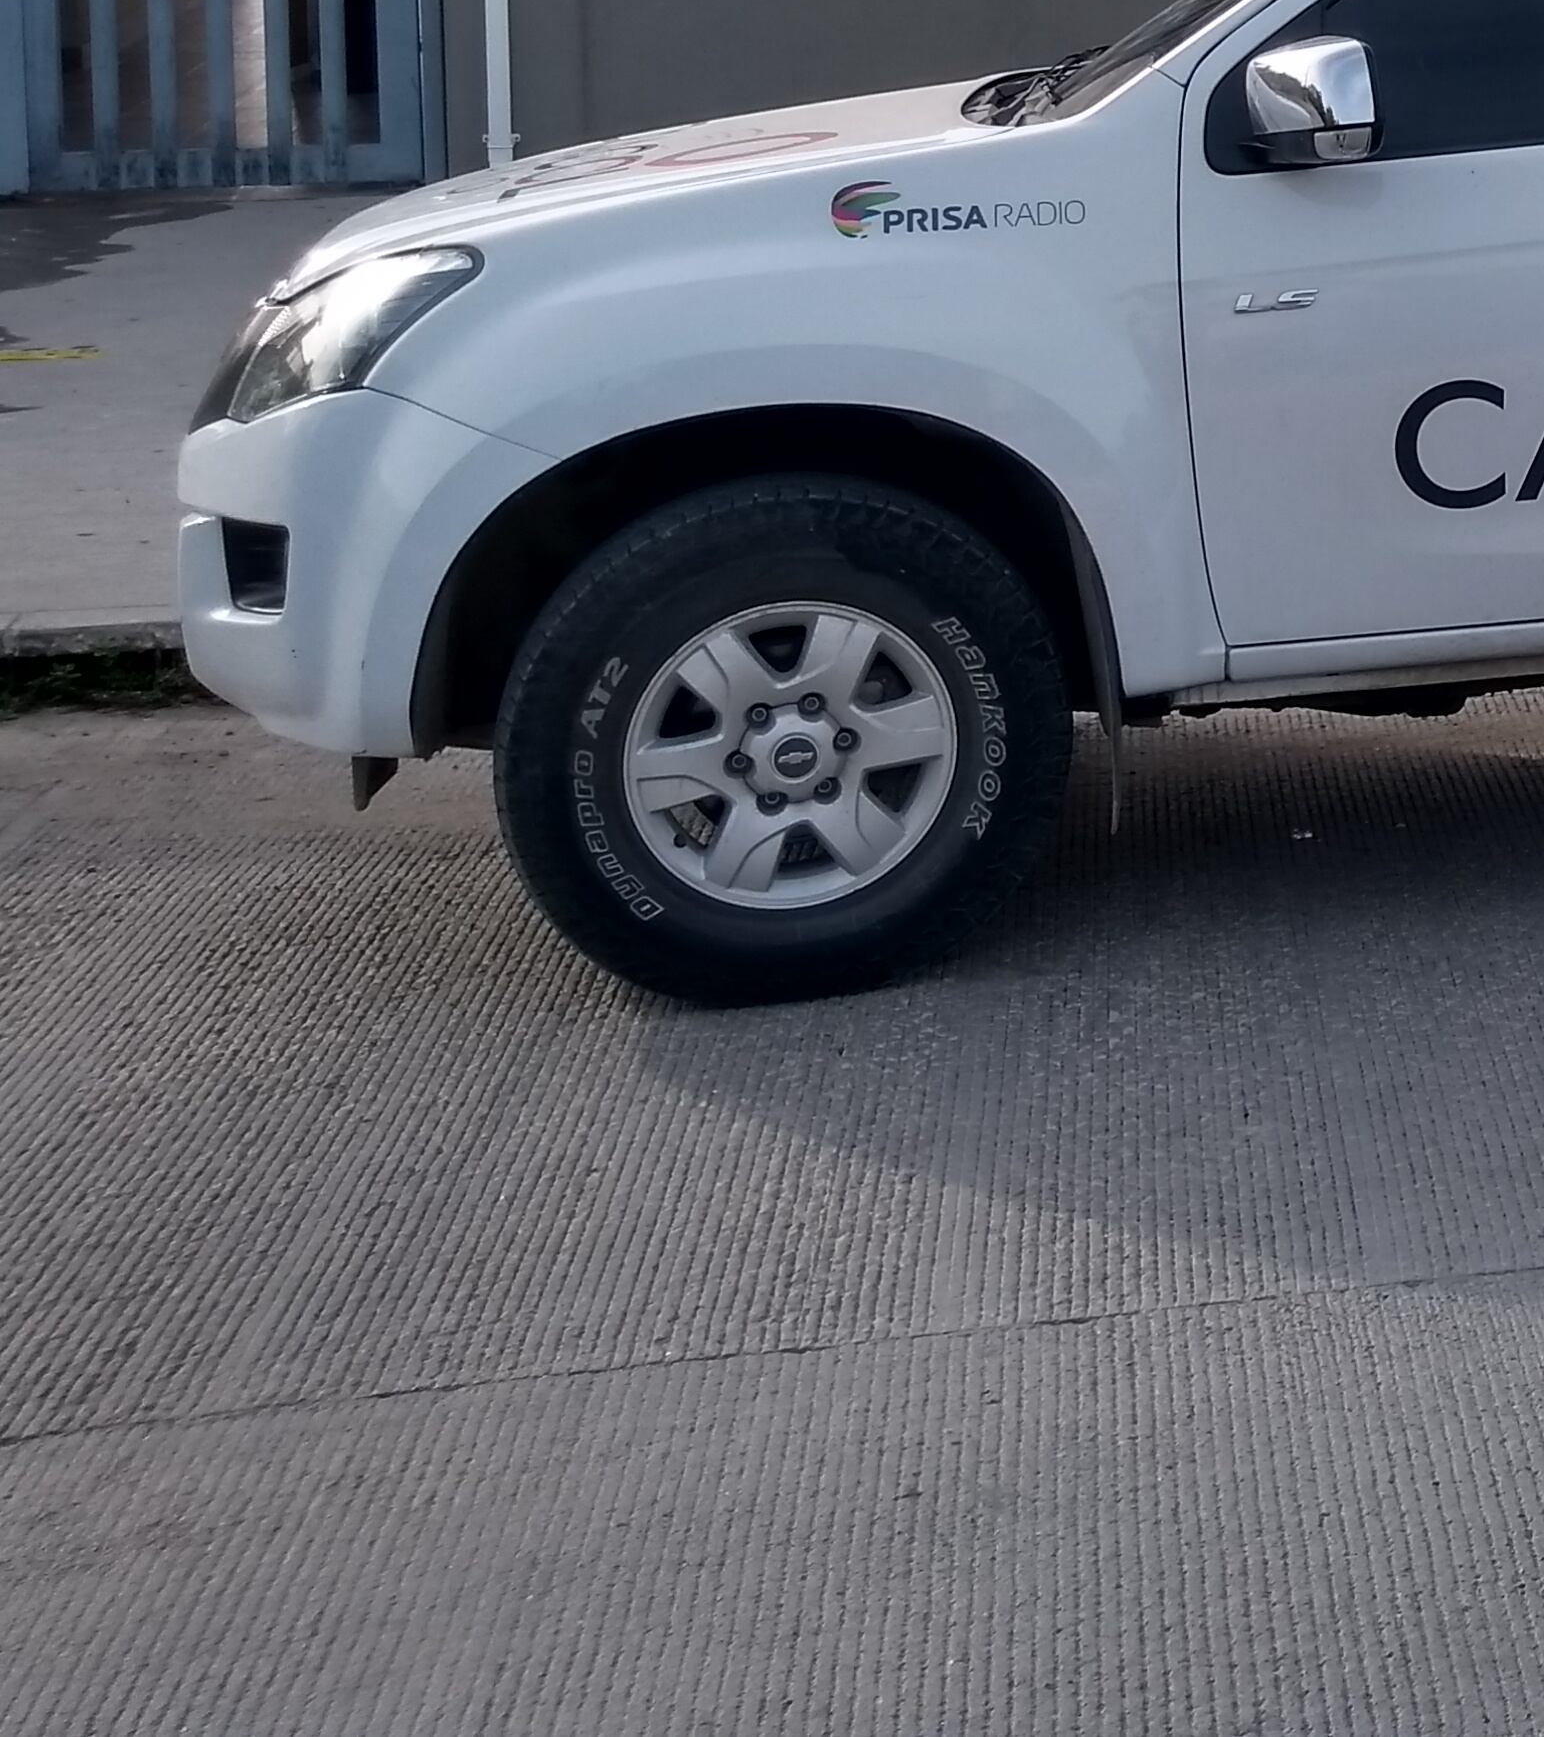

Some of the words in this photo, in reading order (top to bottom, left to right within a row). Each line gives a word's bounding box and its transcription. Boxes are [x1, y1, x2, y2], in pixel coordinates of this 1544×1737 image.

[882, 205, 988, 234] PRISA
[994, 199, 1086, 228] RADIO
[1234, 289, 1319, 314] LS
[584, 656, 629, 739] AT2
[573, 748, 665, 922] Dynapro
